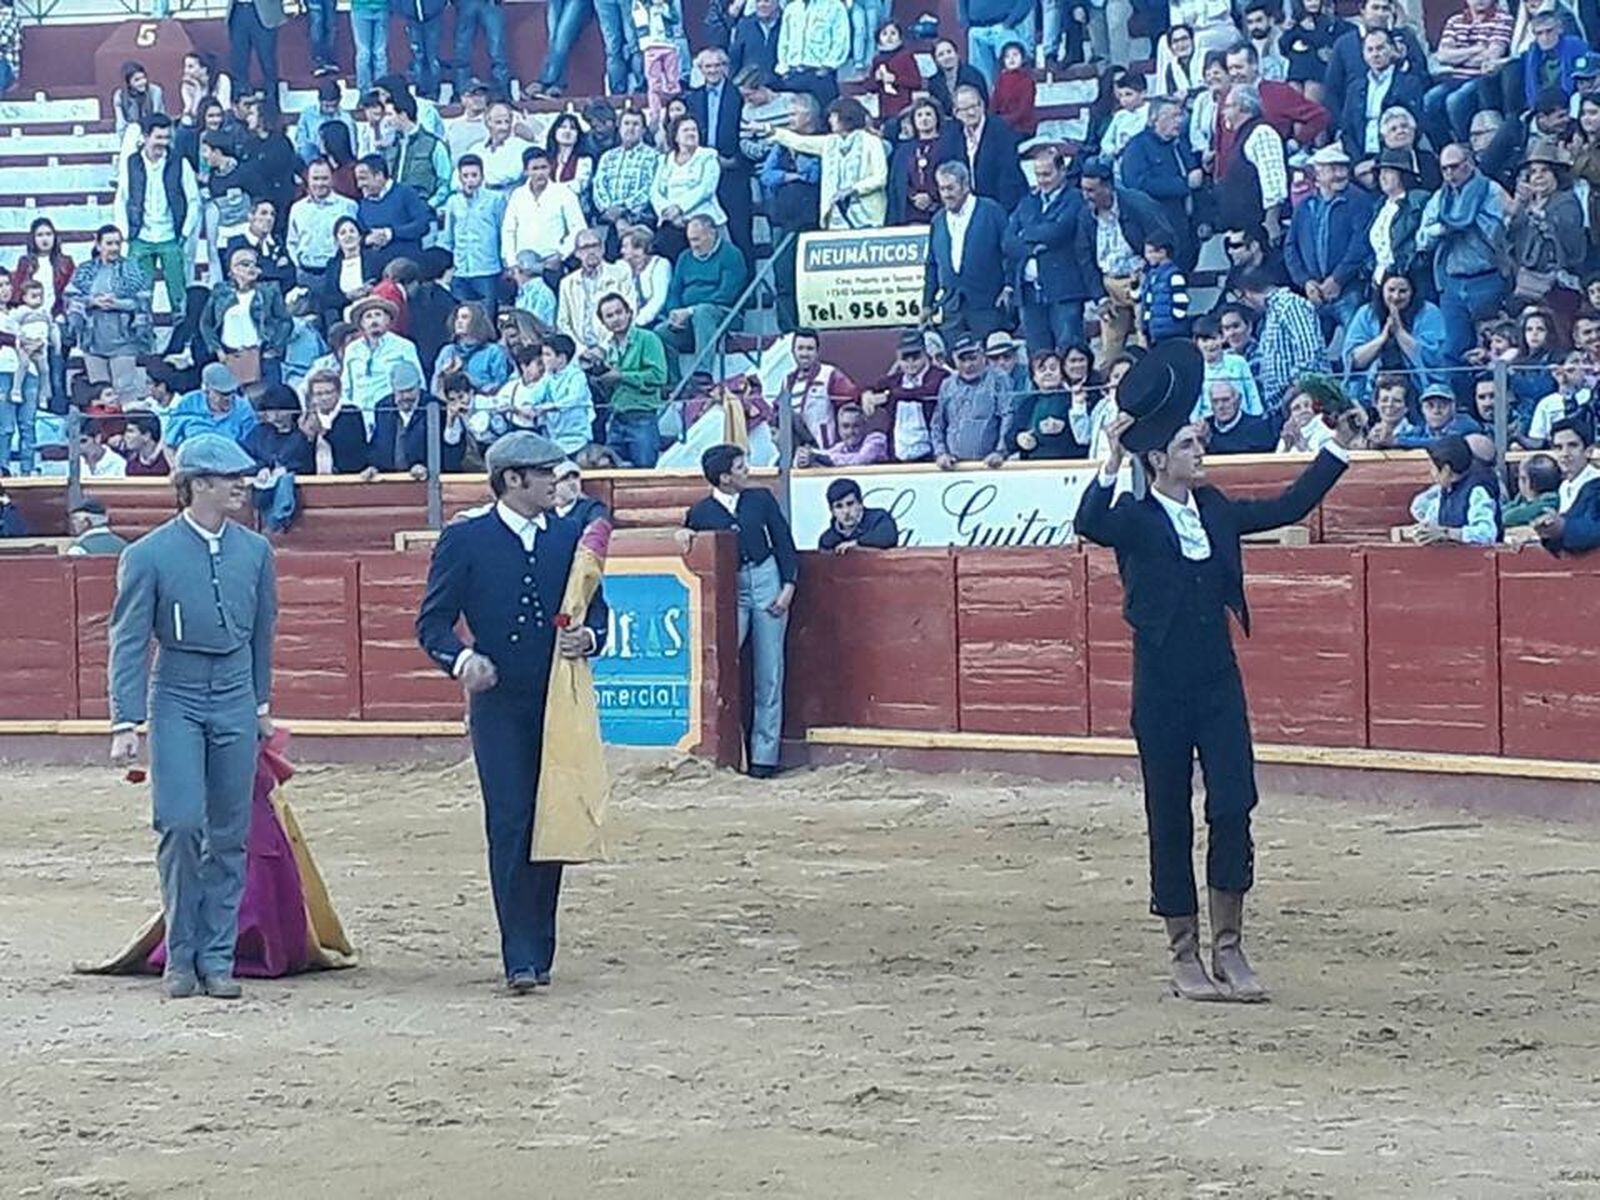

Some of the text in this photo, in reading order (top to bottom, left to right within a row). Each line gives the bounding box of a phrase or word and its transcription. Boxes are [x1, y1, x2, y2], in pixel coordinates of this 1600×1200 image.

[137, 24, 158, 46] 5
[809, 240, 918, 266] NEUMÁTICOS
[808, 299, 920, 321] Tel. 956 36
[594, 682, 681, 707] omercial
